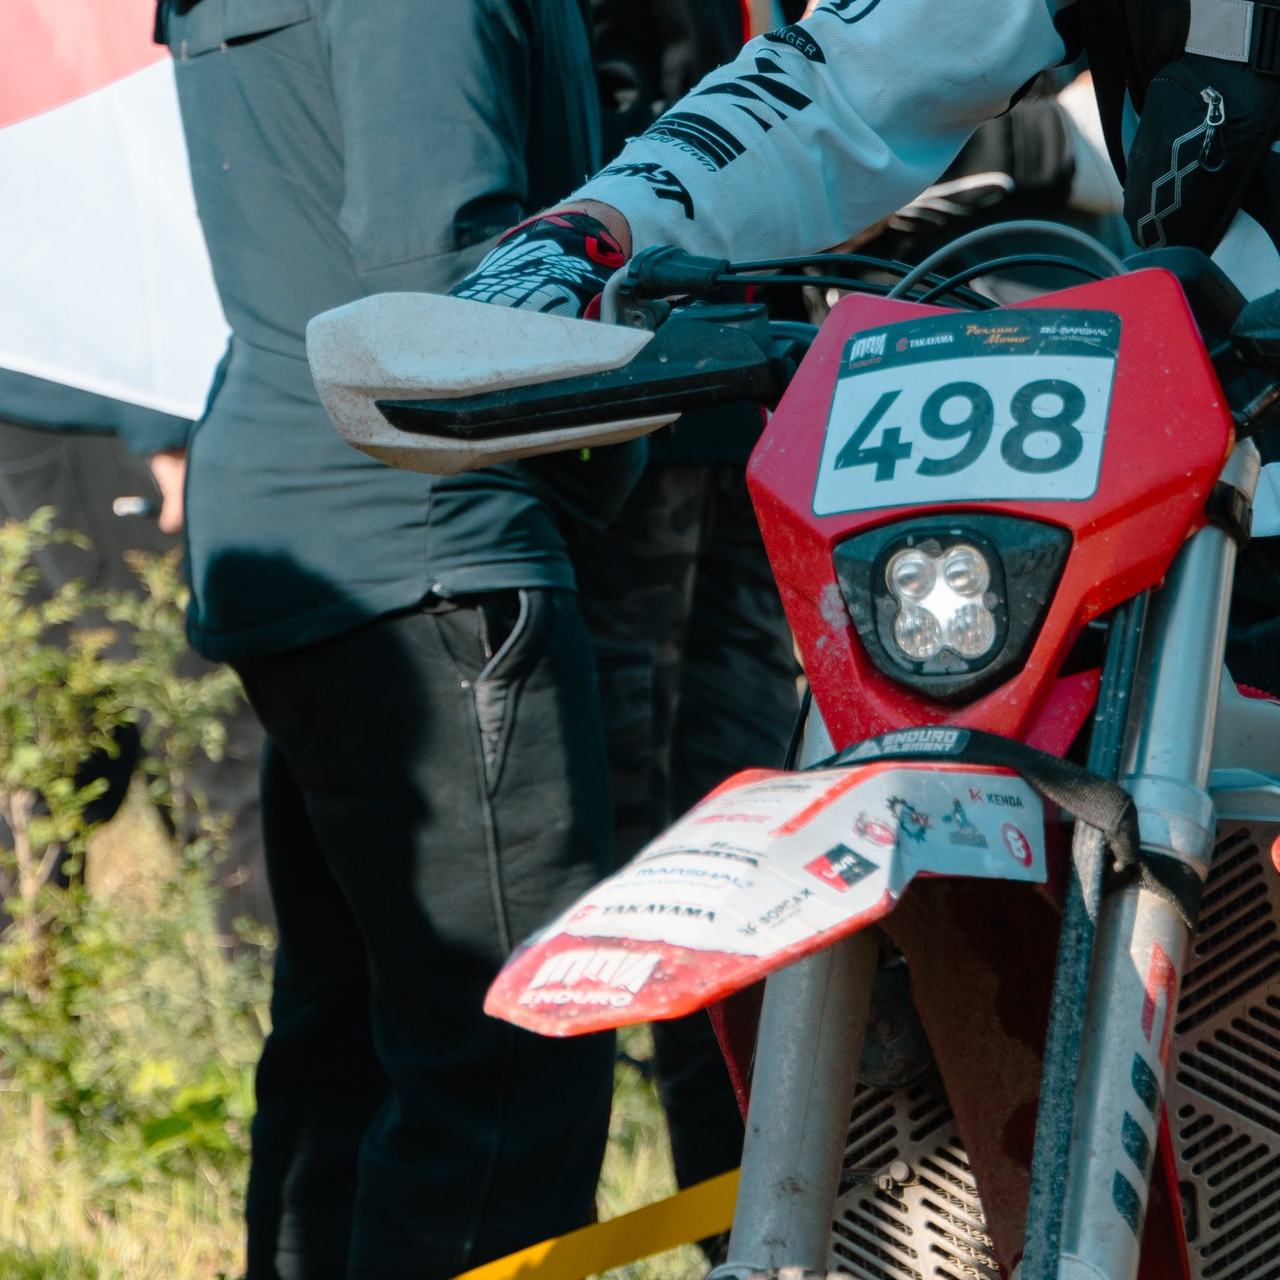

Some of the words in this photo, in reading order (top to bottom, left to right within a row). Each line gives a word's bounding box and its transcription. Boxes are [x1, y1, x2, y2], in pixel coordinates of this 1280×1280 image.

[909, 333, 955, 349] TAKAYAMA
[833, 378, 1087, 483] 498
[882, 729, 959, 745] ENDURO
[985, 792, 1024, 809] KENDA
[602, 903, 716, 923] TAKAYAMA
